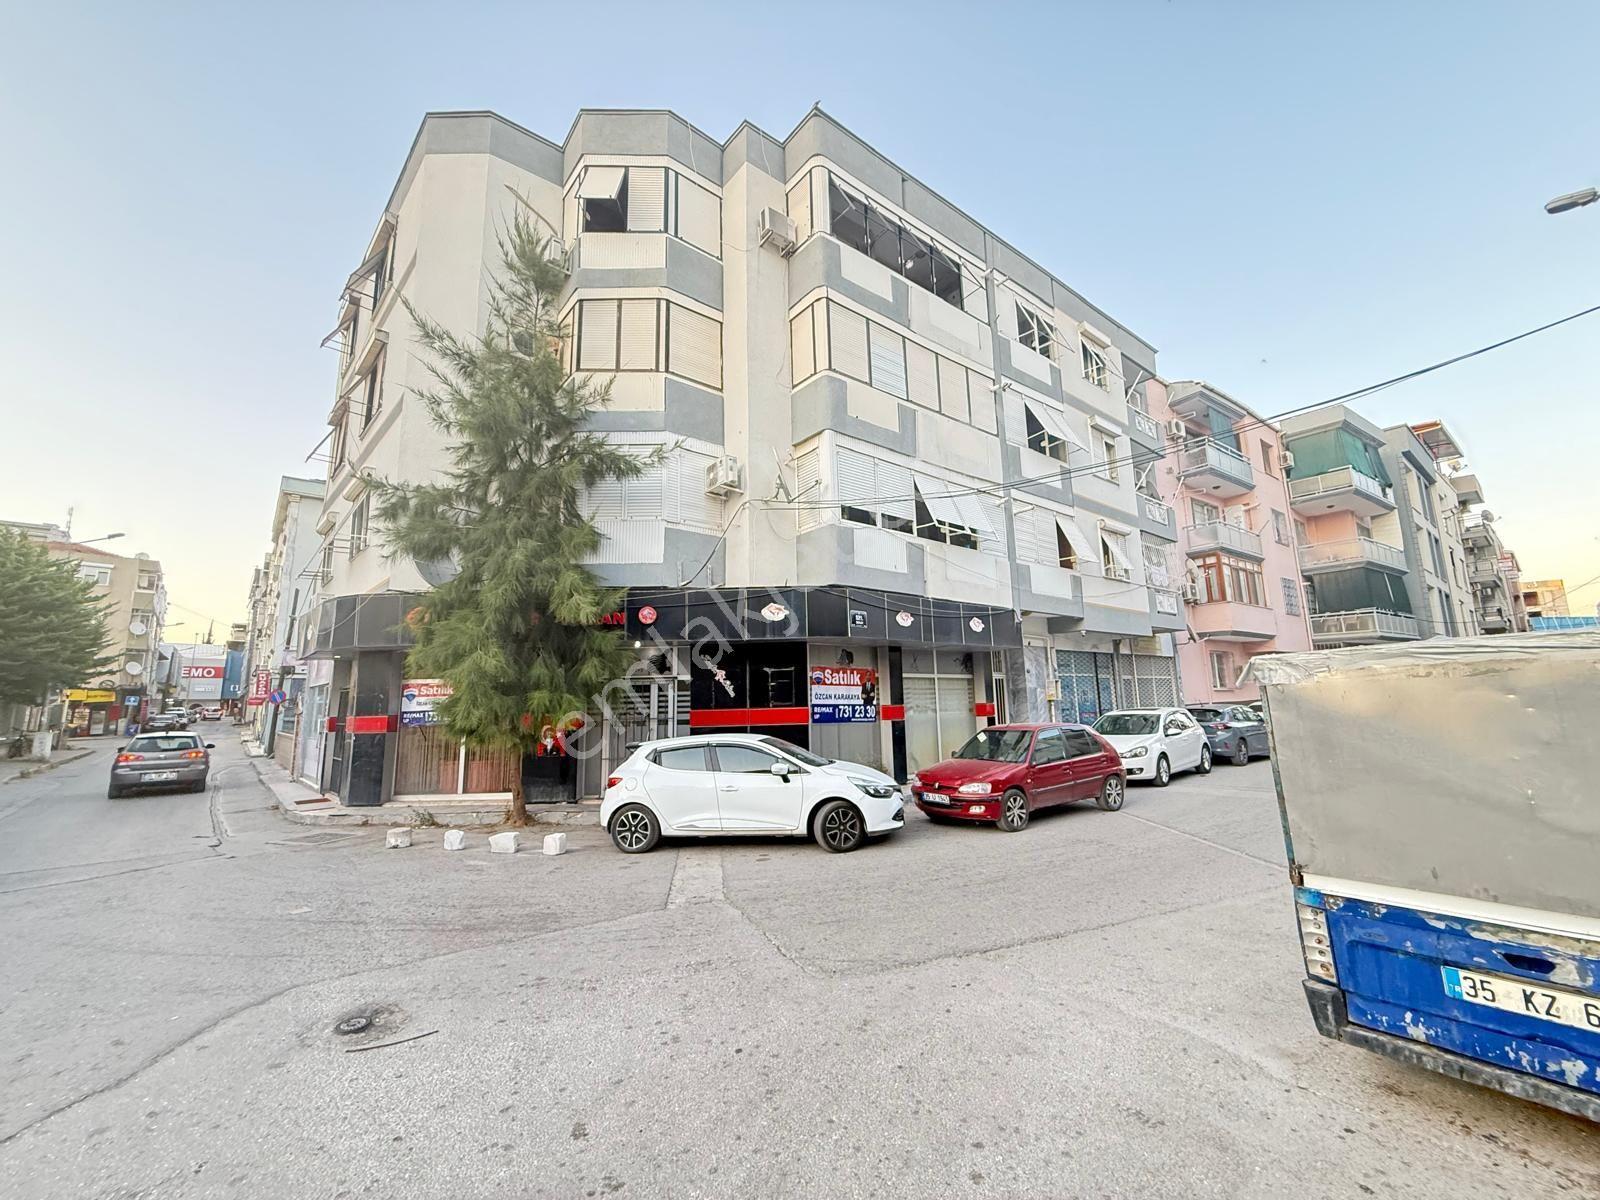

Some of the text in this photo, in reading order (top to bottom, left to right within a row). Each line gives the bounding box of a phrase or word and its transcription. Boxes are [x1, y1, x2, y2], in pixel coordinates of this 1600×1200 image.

[824, 669, 862, 685] Satılık
[815, 692, 832, 700] ÖZCAN
[839, 705, 852, 718] 731
[854, 705, 864, 718] 23
[866, 705, 876, 718] 30
[1462, 976, 1600, 1028] 35 KZ 6
